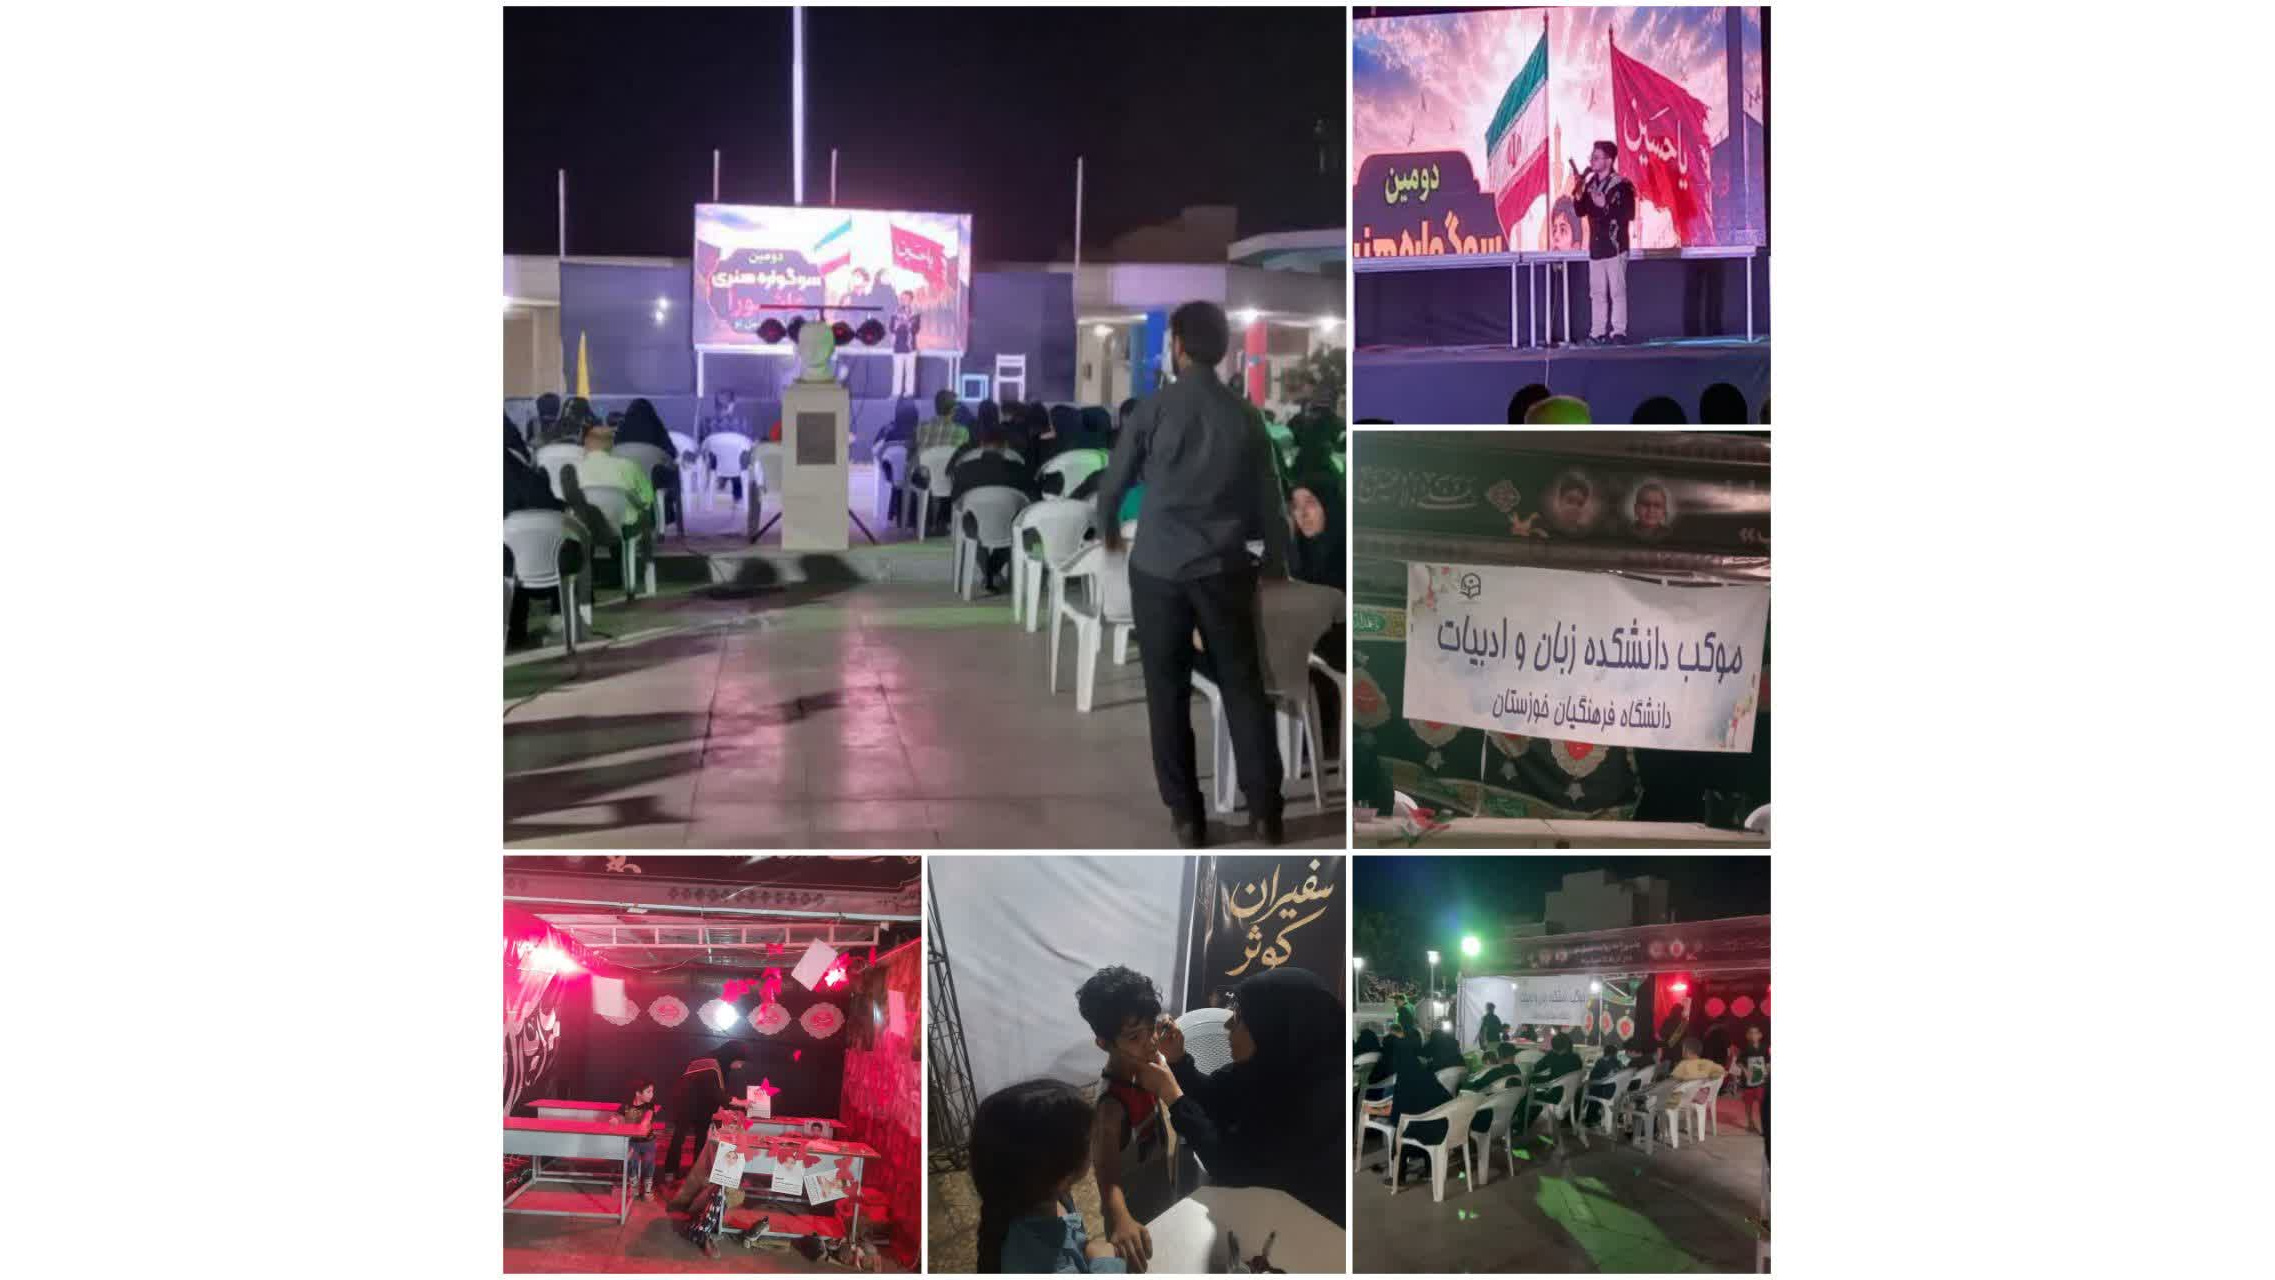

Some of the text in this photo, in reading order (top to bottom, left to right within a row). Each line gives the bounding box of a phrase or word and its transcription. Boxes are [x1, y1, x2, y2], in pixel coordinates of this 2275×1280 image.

[1384, 163, 1440, 204] دومین
[748, 252, 784, 265] دومین
[1437, 615, 1743, 684] موکب دانشکده زبان و ادبیات
[1492, 687, 1672, 732] دانشگاه فرهنگیان خوزستان
[1230, 858, 1335, 925] سفیران
[1224, 905, 1328, 977] کوثر
